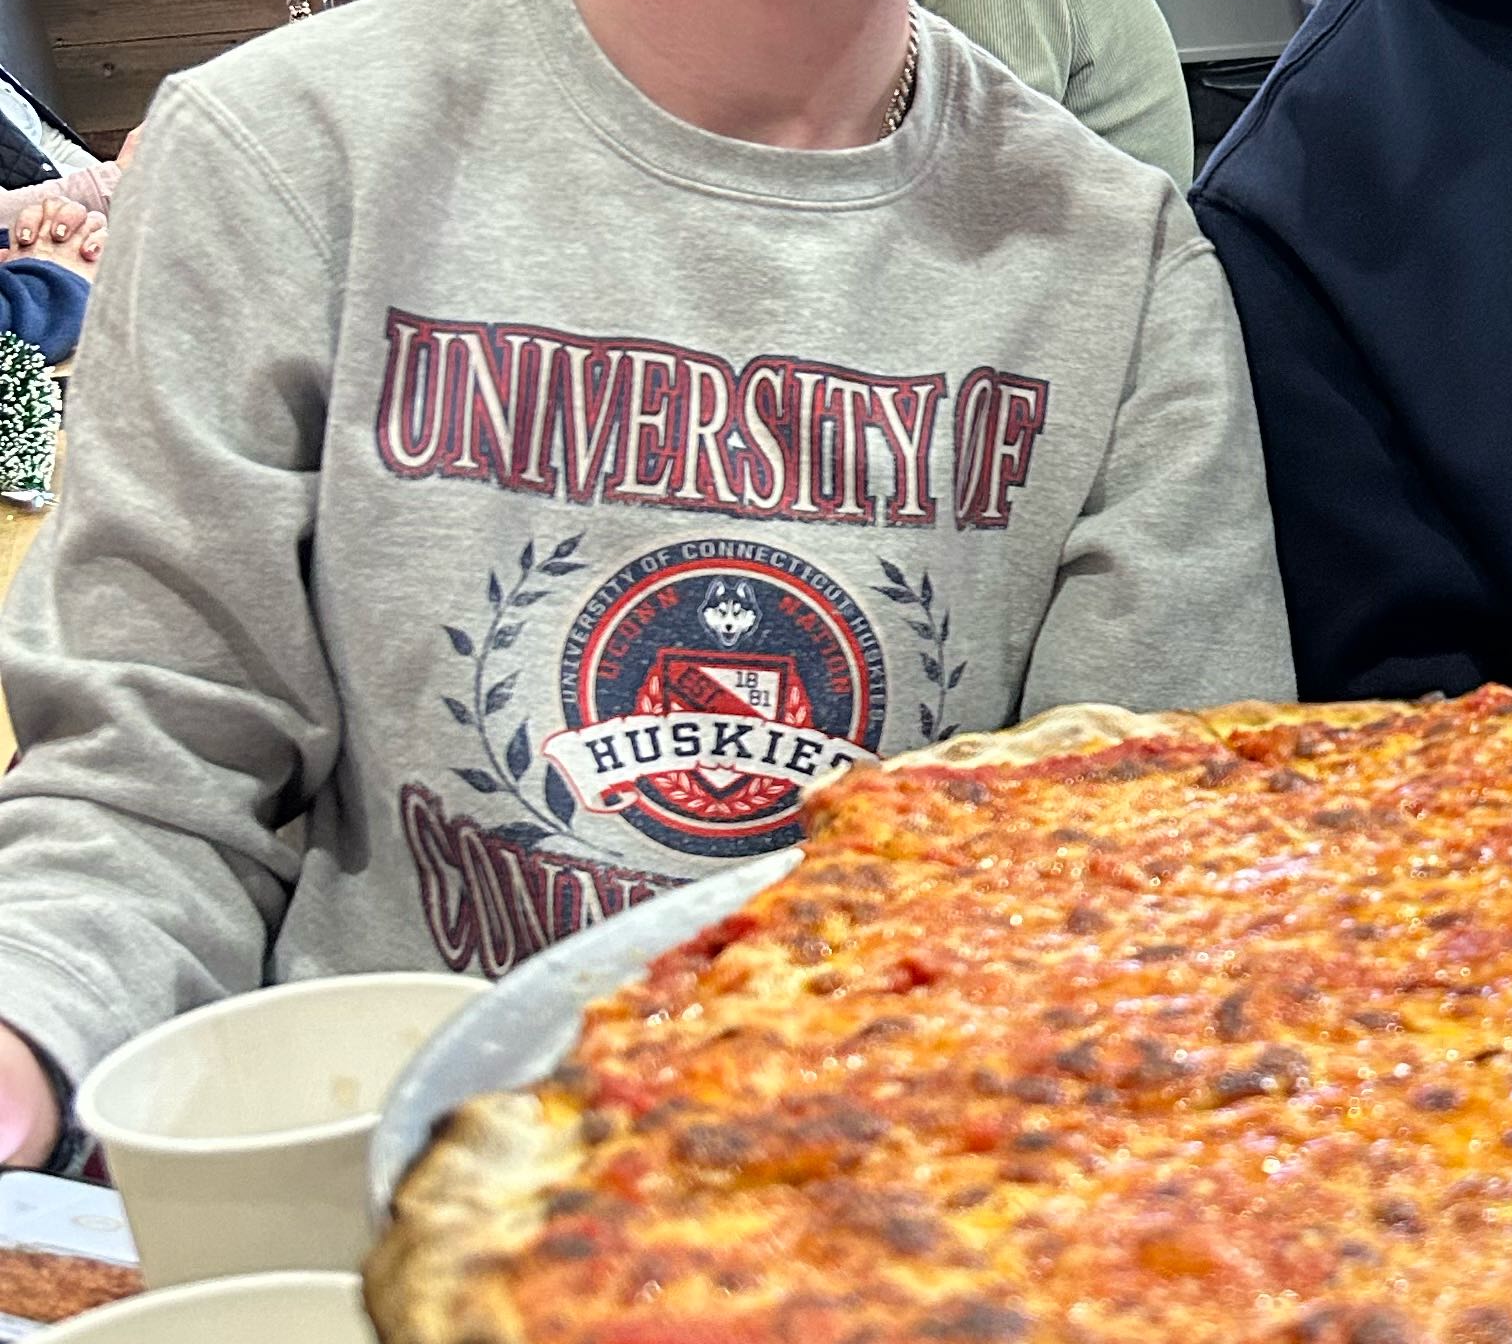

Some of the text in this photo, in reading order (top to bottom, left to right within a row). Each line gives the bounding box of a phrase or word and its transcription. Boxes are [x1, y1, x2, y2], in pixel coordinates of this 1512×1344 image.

[377, 306, 1050, 531] UNIVERSITY OF
[561, 566, 636, 704] UNIVERSITY
[639, 548, 672, 574] OF
[680, 540, 852, 611] CONNECTICUT
[598, 585, 852, 696] UCONN NATION
[735, 670, 759, 689] 18
[749, 689, 771, 707] 81
